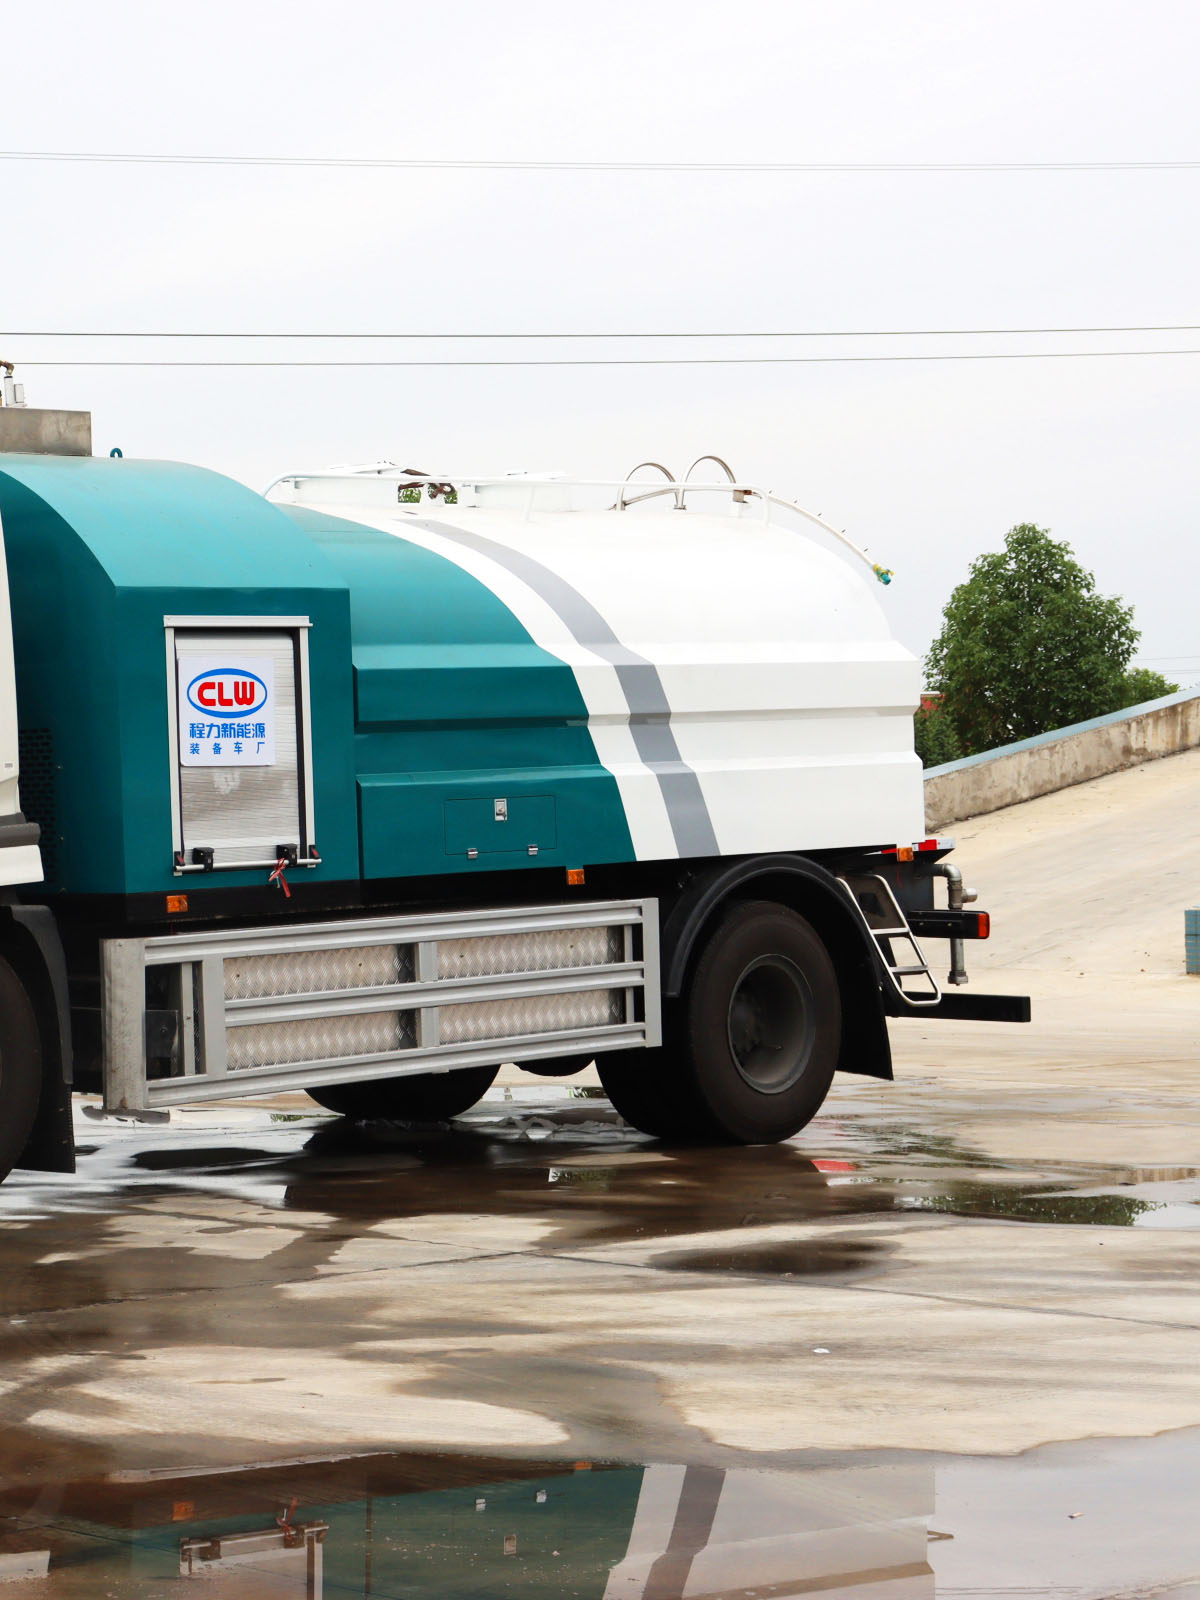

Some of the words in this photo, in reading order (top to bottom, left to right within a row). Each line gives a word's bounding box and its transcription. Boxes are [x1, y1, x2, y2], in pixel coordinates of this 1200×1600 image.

[197, 681, 255, 707] CLW
[189, 722, 266, 739] 程力新能源
[189, 741, 265, 755] 装备车厂
